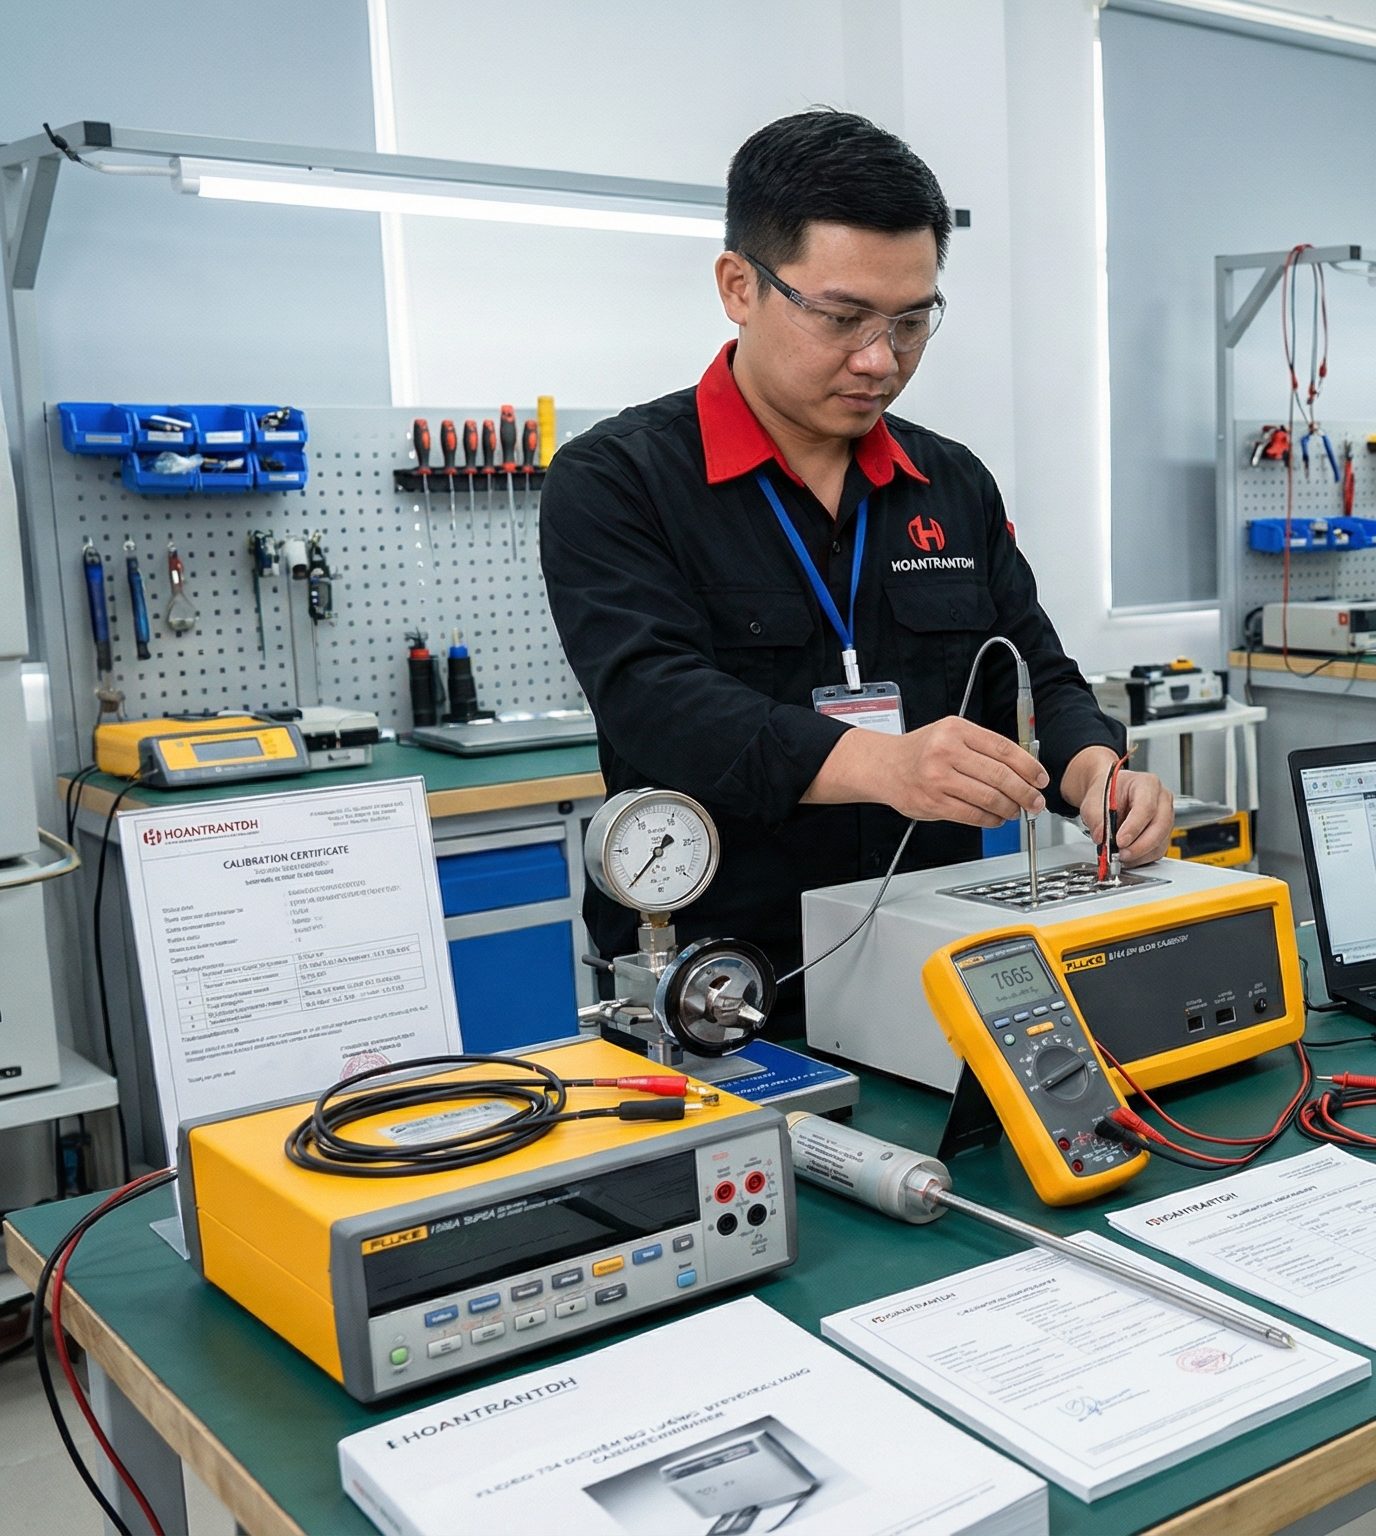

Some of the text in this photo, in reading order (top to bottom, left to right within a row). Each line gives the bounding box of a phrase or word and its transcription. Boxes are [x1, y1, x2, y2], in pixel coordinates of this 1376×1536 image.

[164, 819, 259, 840] HOANTRANTDH
[223, 853, 288, 870] CALIBRATION
[402, 1376, 578, 1444] HOANTRANTDH
